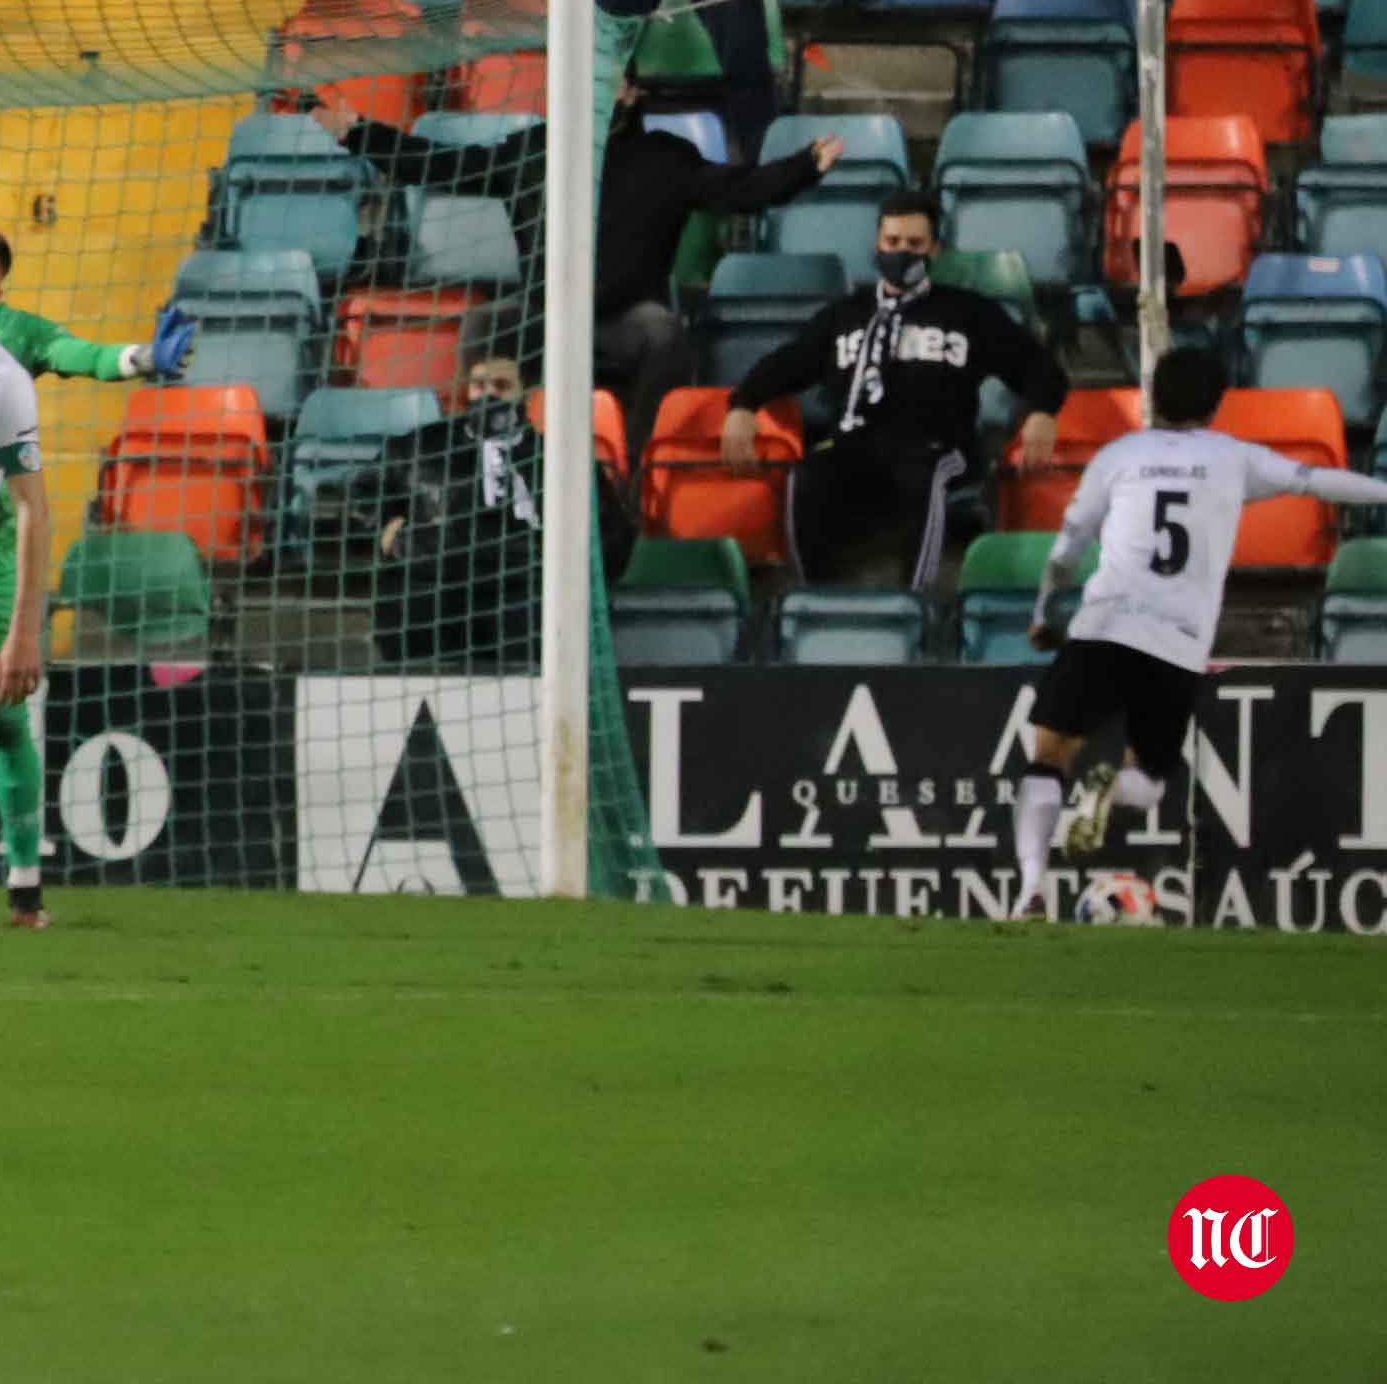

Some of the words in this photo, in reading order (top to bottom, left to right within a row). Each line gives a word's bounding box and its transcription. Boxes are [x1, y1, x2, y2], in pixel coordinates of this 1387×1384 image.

[33, 192, 57, 225] 6
[1149, 489, 1190, 577] 5
[791, 778, 1097, 807] QUESERA
